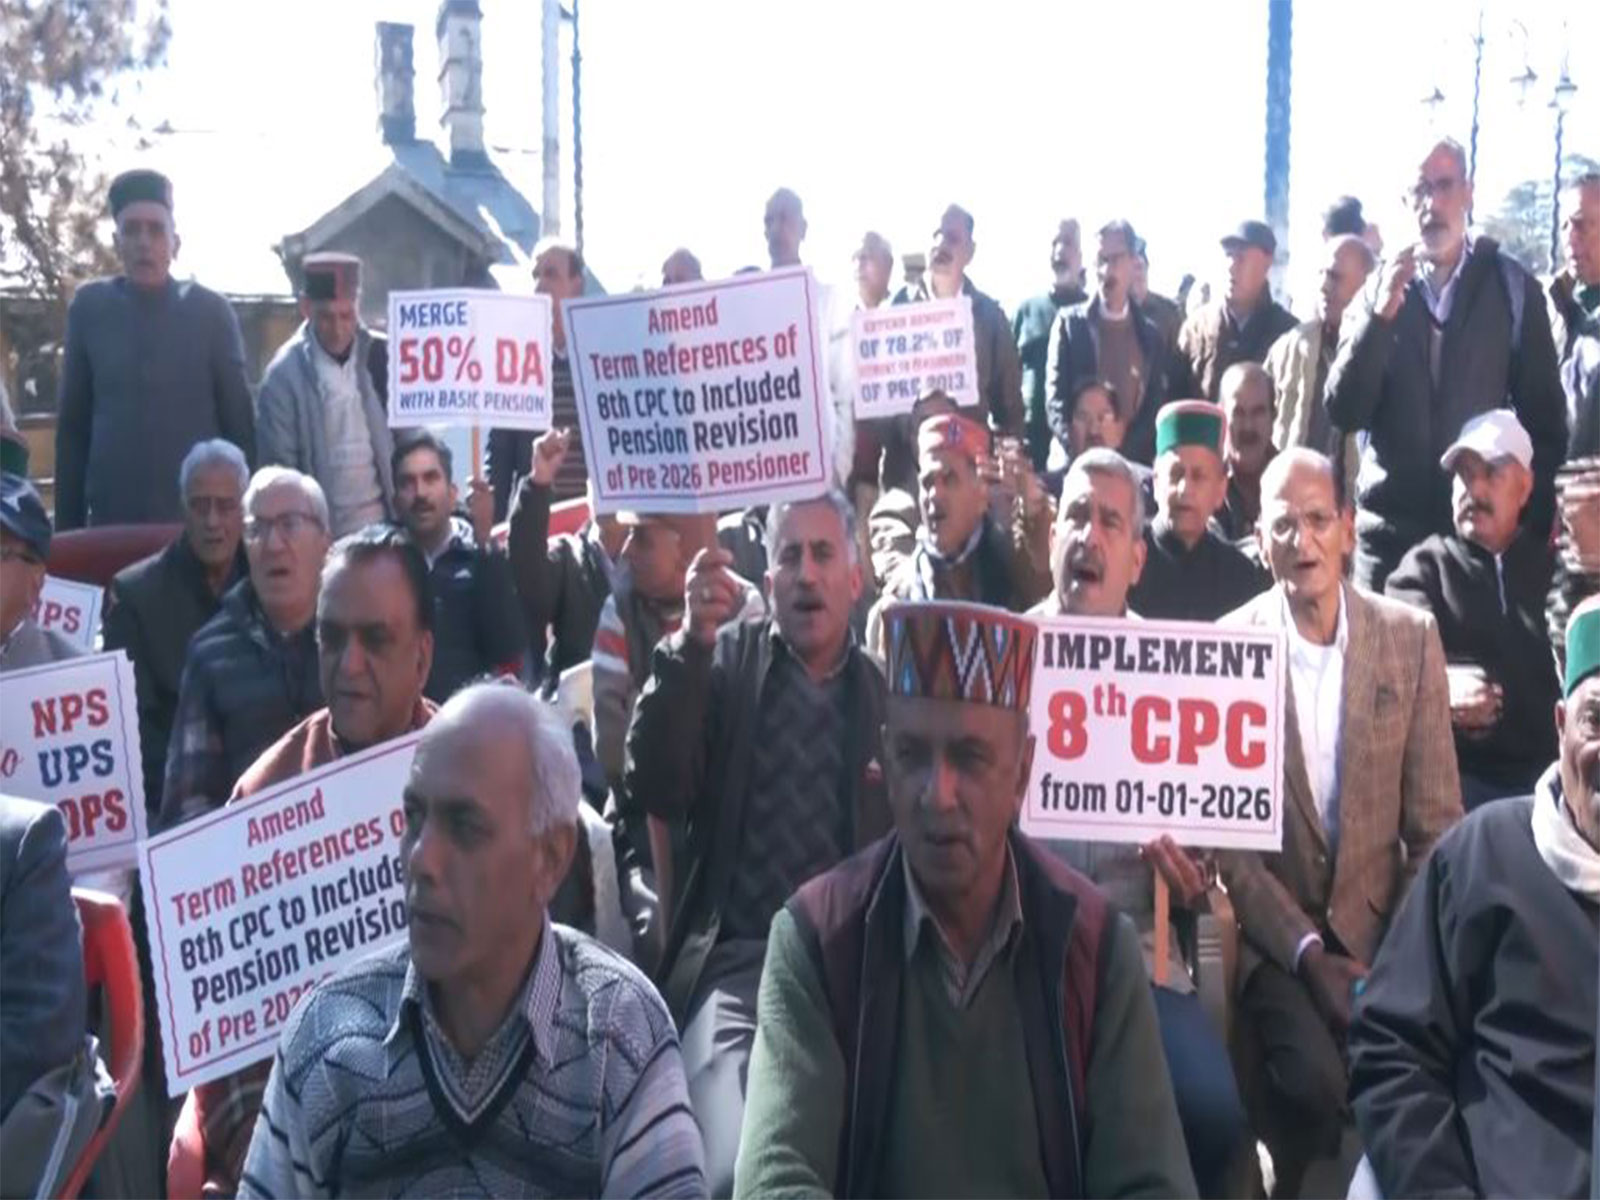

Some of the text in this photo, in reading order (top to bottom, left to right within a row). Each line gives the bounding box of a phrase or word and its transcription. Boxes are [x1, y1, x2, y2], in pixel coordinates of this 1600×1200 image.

[401, 302, 467, 328] MERGE
[649, 296, 718, 335] Amend
[400, 336, 543, 386] 50% DA
[590, 324, 797, 381] Term References of
[859, 338, 879, 359] OF
[943, 328, 963, 349] OF
[401, 390, 544, 412] WITH BASIC PENSION
[597, 366, 801, 420] 8th CPC to Included
[861, 382, 881, 402] OF
[608, 409, 799, 456] Pension Revision
[607, 451, 810, 490] of Pre 2026 Pensioner
[1043, 632, 1272, 679] IMPLEMENT
[31, 688, 109, 738] NPS
[38, 739, 114, 788] UPS
[248, 788, 325, 848] Amend
[1041, 773, 1271, 821] from 01-01-2026
[172, 809, 405, 927] Term References o
[180, 854, 403, 972] 8th CPC to Include
[192, 898, 407, 1013] Pension Revisio
[189, 1019, 211, 1059] of
[218, 1008, 256, 1046] Pre
